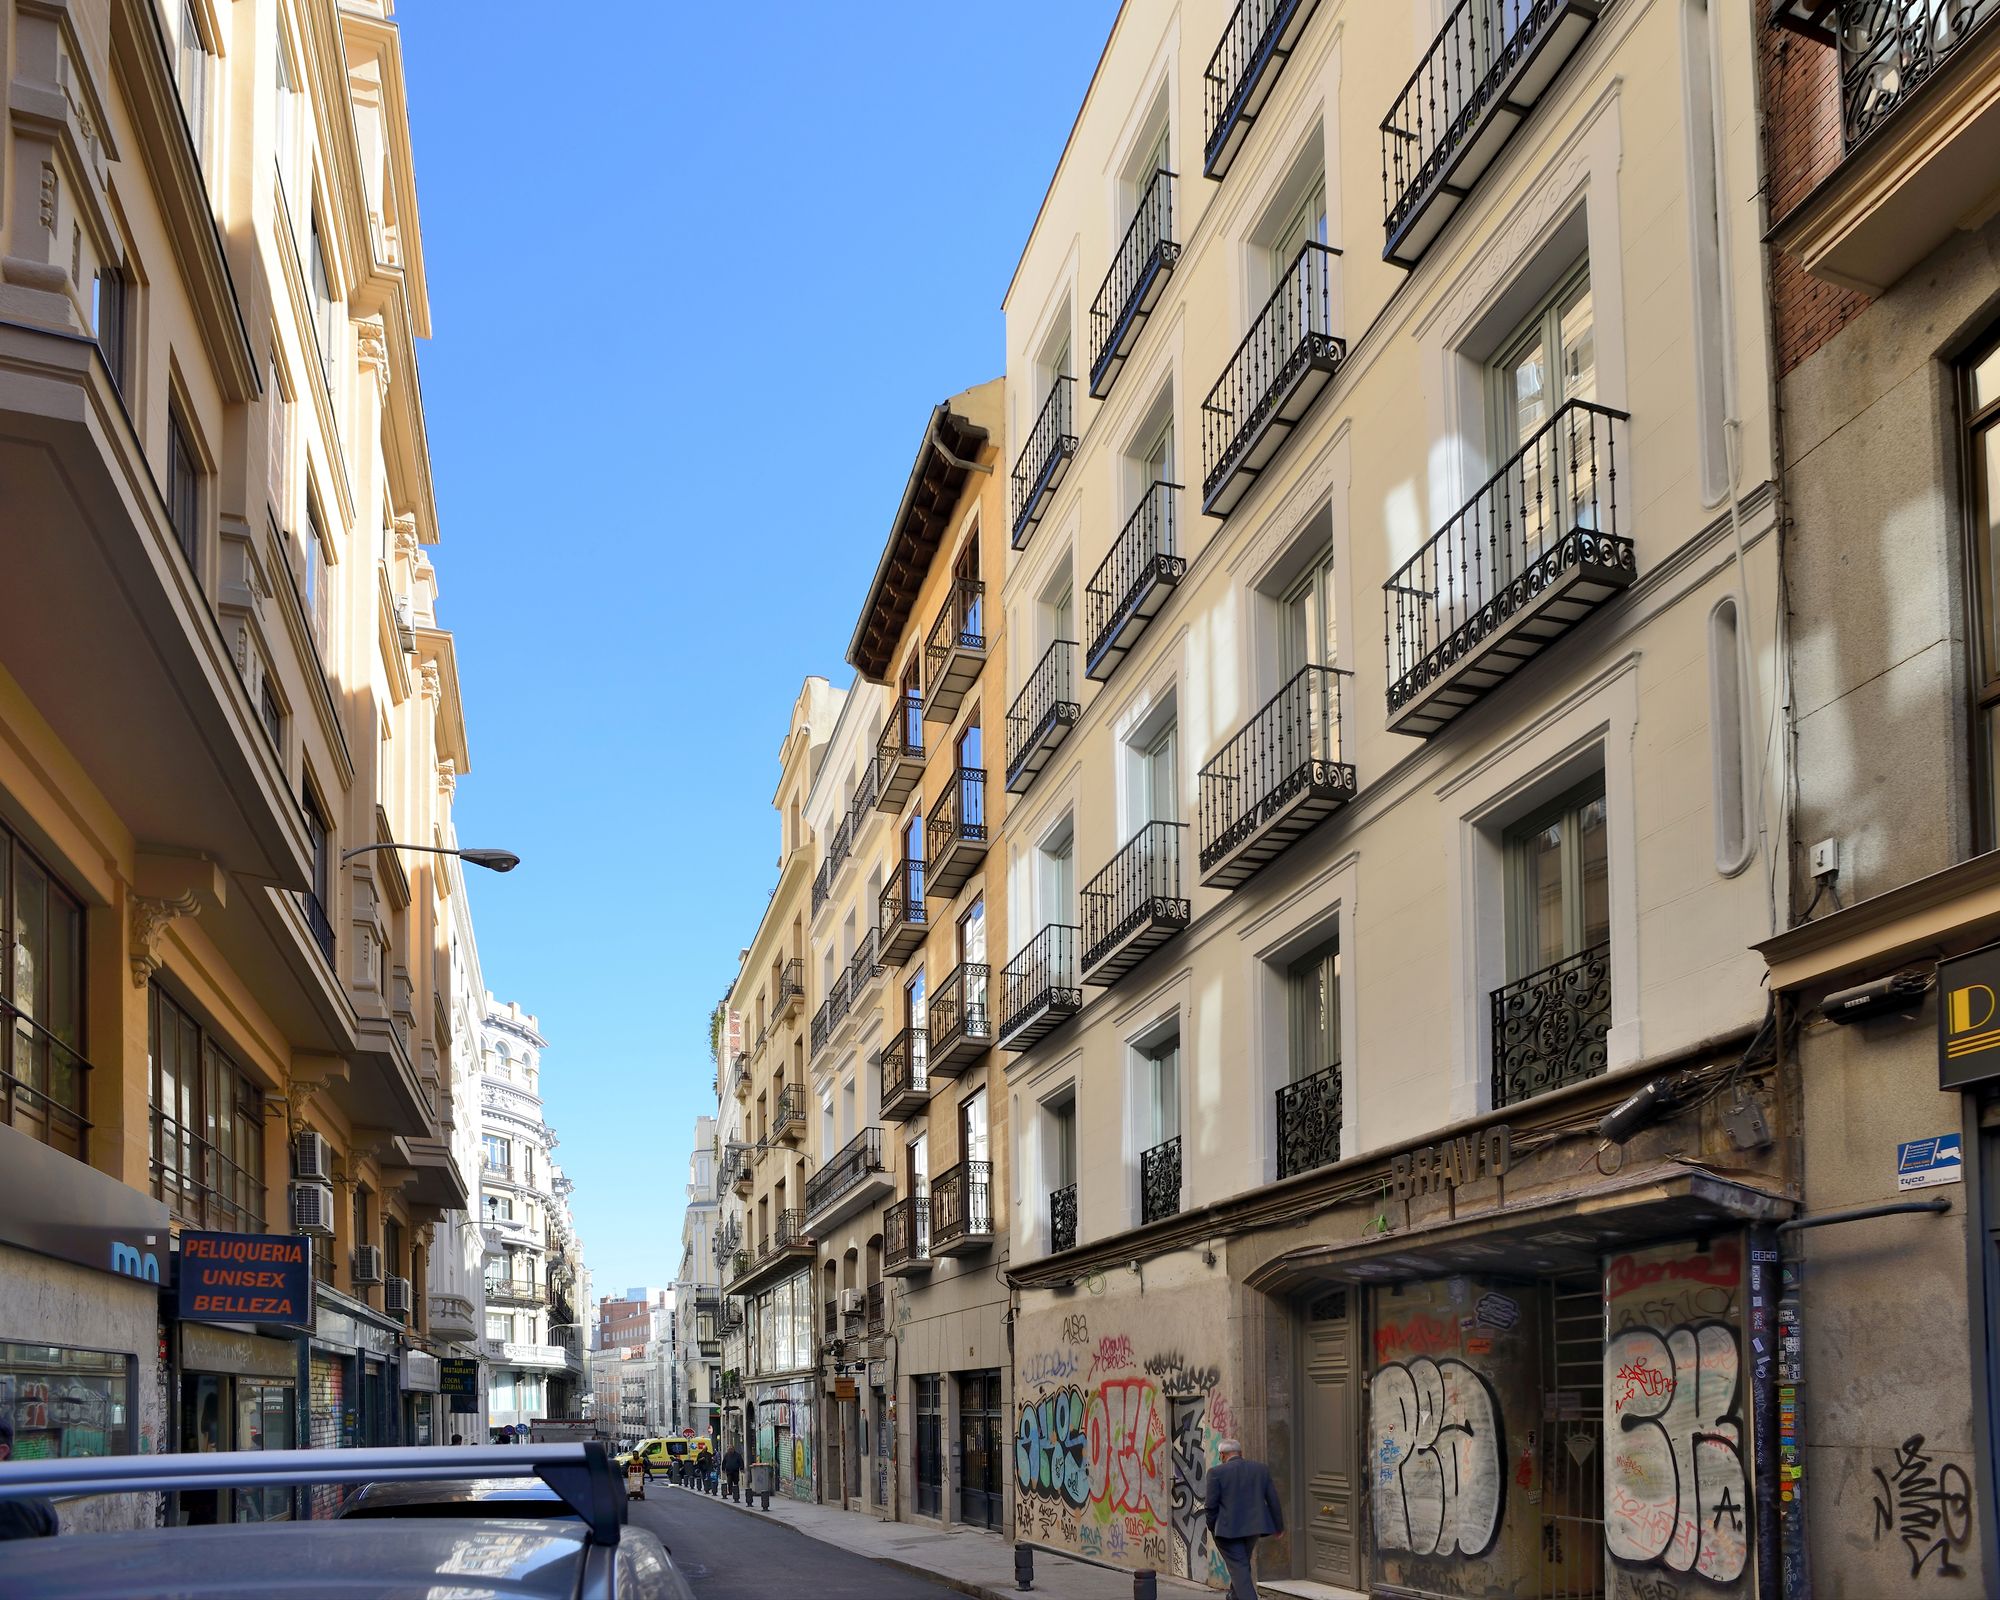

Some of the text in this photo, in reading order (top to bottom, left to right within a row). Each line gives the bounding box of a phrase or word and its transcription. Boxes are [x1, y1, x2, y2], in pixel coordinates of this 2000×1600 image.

[1391, 1124, 1512, 1202] BRAVO
[1900, 1175, 1925, 1185] tyco
[184, 1239, 303, 1264] PELUQUERIA
[1752, 1251, 1777, 1261] GECO
[202, 1269, 286, 1288] UNISEX
[193, 1295, 293, 1314] BELLEZA
[442, 1367, 476, 1375] RESTAURANTE
